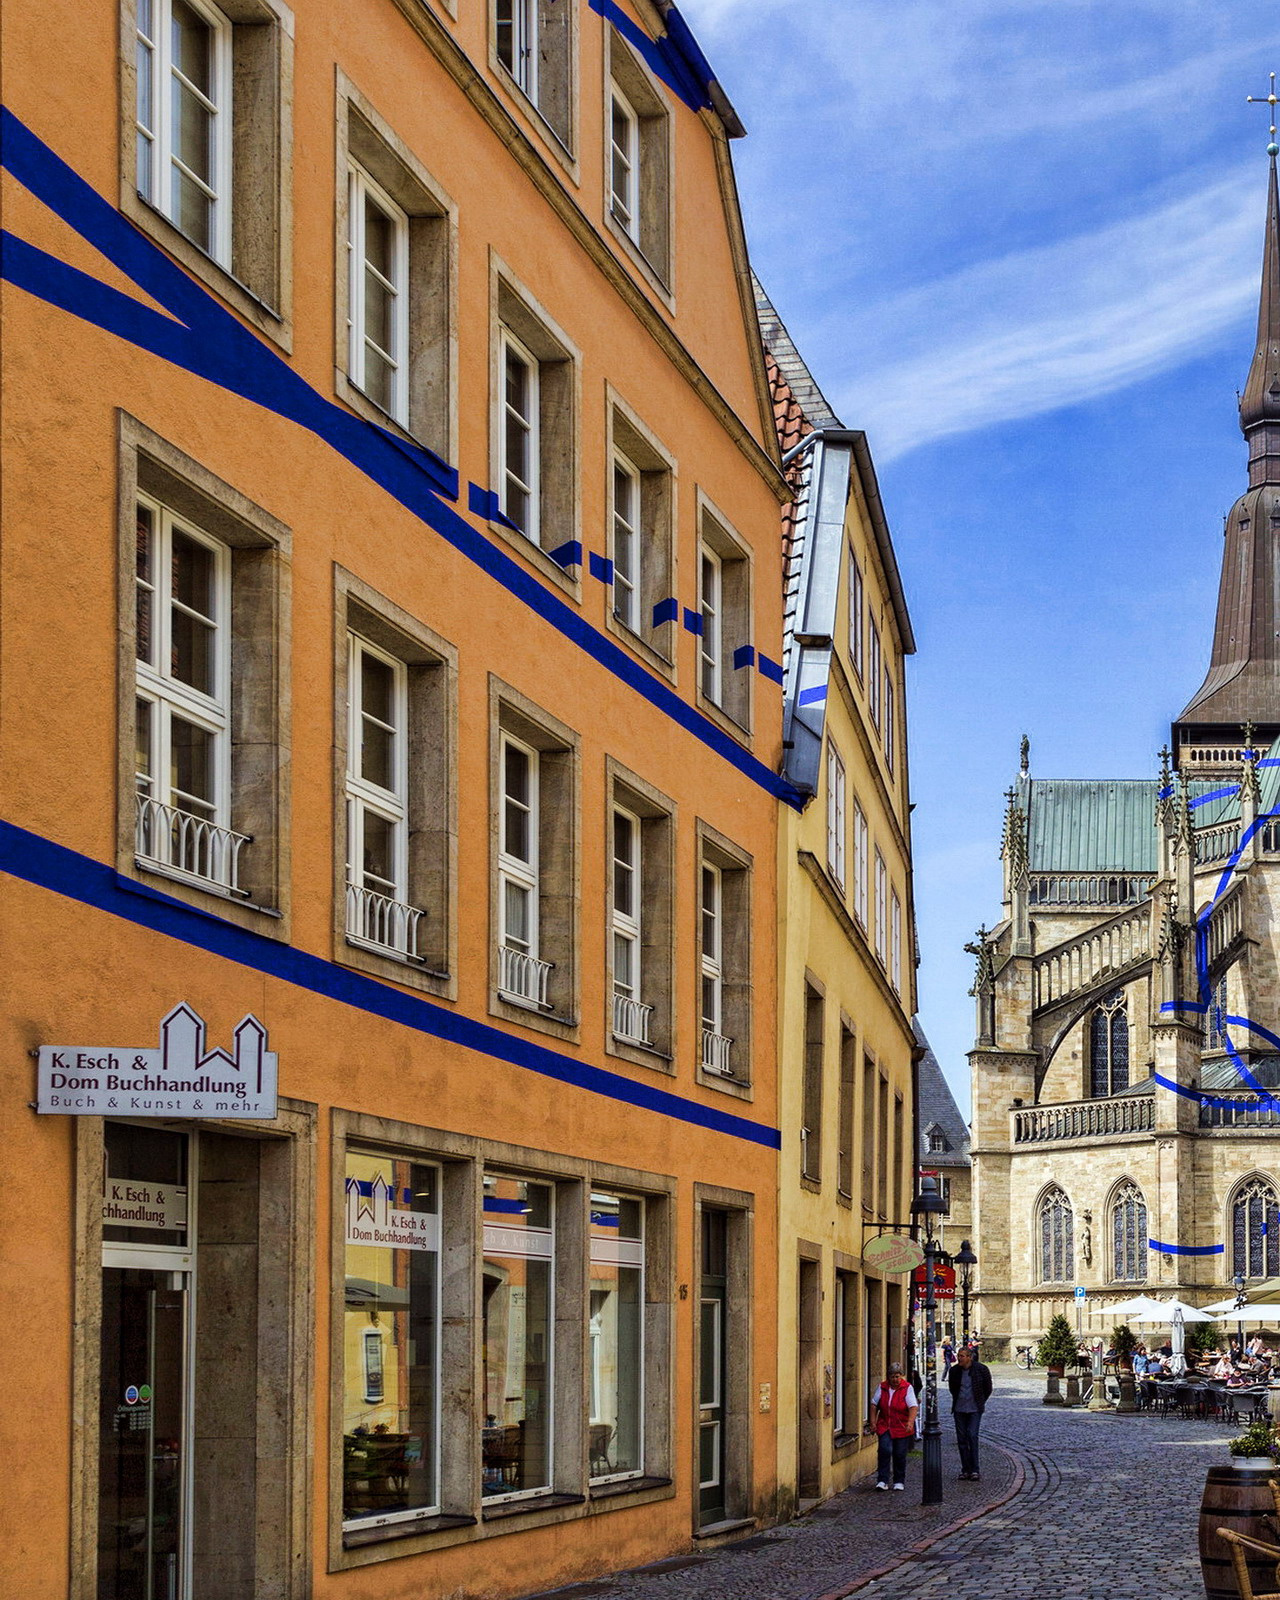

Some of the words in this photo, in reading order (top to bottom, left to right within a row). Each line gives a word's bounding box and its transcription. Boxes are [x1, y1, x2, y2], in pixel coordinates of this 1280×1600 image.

[51, 1053, 70, 1069] K.
[76, 1053, 120, 1070] Esch
[131, 1055, 148, 1070] &
[51, 1073, 99, 1090] Dom
[106, 1074, 247, 1098] Buchhandlung
[51, 1095, 96, 1108] Buch
[107, 1097, 118, 1108] &
[130, 1097, 182, 1109] Kunst
[193, 1099, 203, 1110] &
[215, 1099, 260, 1111] mehr
[112, 1185, 123, 1200] K.
[126, 1187, 150, 1203] Esch
[156, 1190, 166, 1204] &
[391, 1215, 399, 1228] K.
[401, 1217, 417, 1229] Esch
[420, 1219, 427, 1231] &
[352, 1227, 372, 1240] Dom
[374, 1229, 427, 1249] Buchhandlung
